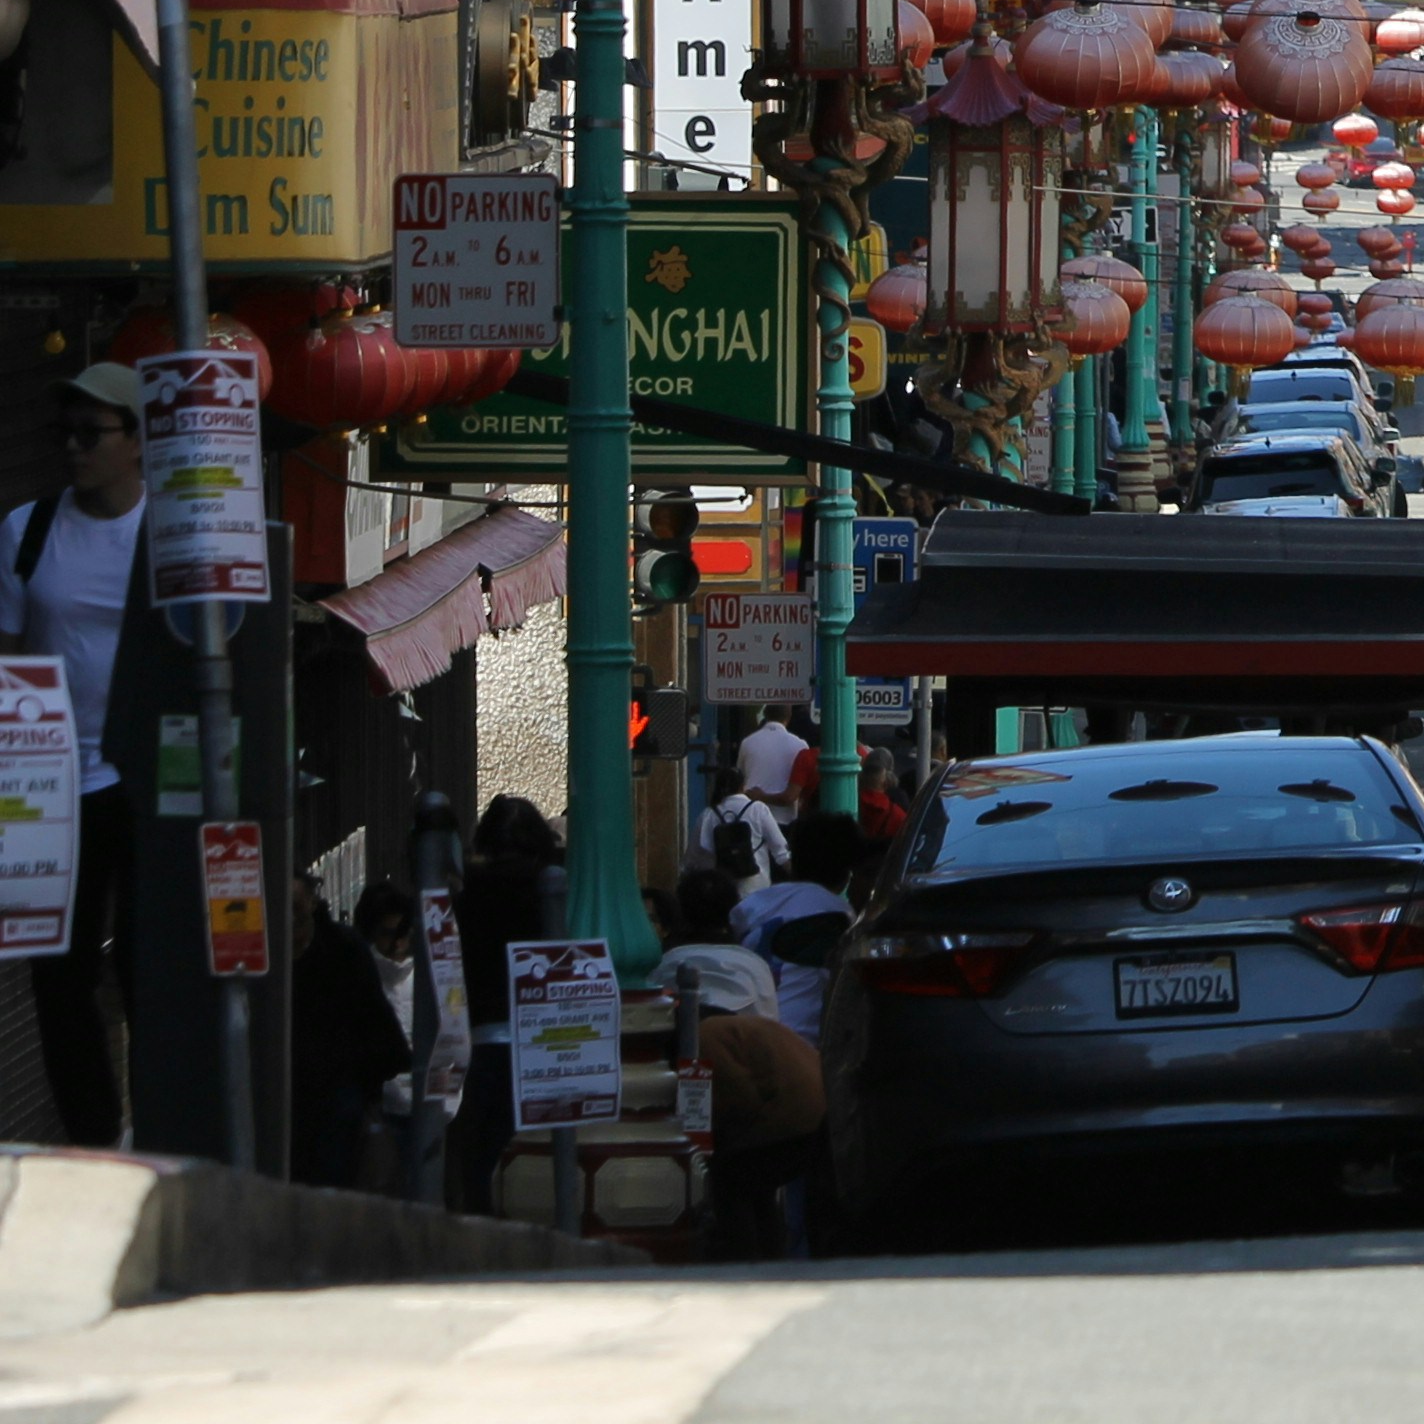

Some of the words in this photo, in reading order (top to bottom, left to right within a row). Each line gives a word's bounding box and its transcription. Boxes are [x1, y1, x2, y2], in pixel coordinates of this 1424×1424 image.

[144, 177, 249, 236] Dm
[269, 176, 335, 237] Sum
[401, 182, 442, 224] NO
[451, 190, 551, 223] PARKING
[411, 236, 427, 268] 2
[432, 251, 460, 267] A.M.
[495, 235, 511, 266] 6
[411, 282, 451, 309] MON
[459, 287, 492, 301] THRU
[505, 281, 536, 307] FRI
[411, 325, 465, 341] STREET
[470, 323, 546, 340] CLEANING
[461, 415, 568, 434] ORIENT
[863, 528, 909, 548] here
[709, 597, 738, 625] NO
[743, 604, 809, 625] PARKING
[717, 633, 727, 653] 2
[772, 632, 783, 652] 6
[717, 662, 743, 678] MON
[747, 664, 769, 674] THRU
[778, 660, 798, 677] FRI
[717, 688, 751, 699] STREET
[755, 688, 805, 699] CLEANING
[520, 987, 544, 1000] NO
[550, 982, 613, 998] STOPPING
[1123, 975, 1229, 1009] 7TSZ094
